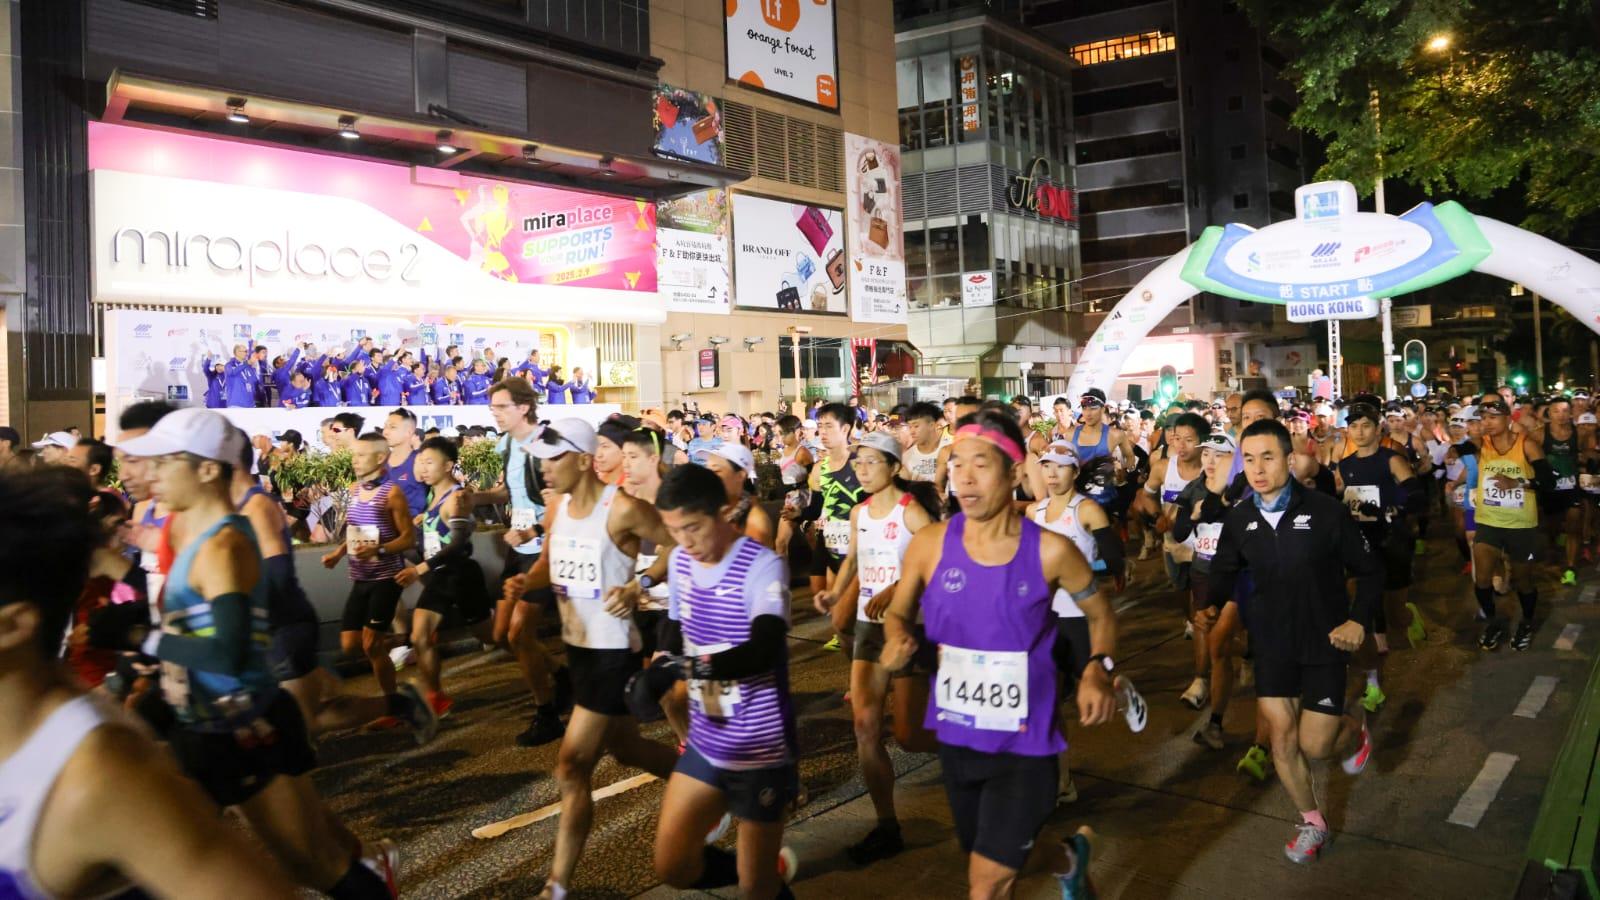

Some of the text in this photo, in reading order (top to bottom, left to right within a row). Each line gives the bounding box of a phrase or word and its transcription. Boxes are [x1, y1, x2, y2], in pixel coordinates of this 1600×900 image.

[747, 29, 816, 60] orange forest
[774, 67, 789, 77] LEVEL
[1010, 157, 1045, 212] The
[524, 206, 612, 231] miraplace
[524, 226, 613, 257] SUPPORTS
[111, 228, 419, 288] miraplace 2
[662, 248, 668, 257] F
[669, 249, 675, 258] &
[742, 244, 792, 257] BRAND OFF
[556, 267, 591, 282] 2025.2.9
[869, 265, 887, 277] F & F
[1299, 284, 1349, 299] START
[1290, 300, 1363, 317] HONG KONG
[1485, 488, 1522, 500] 12016
[943, 677, 1021, 709] 14489
